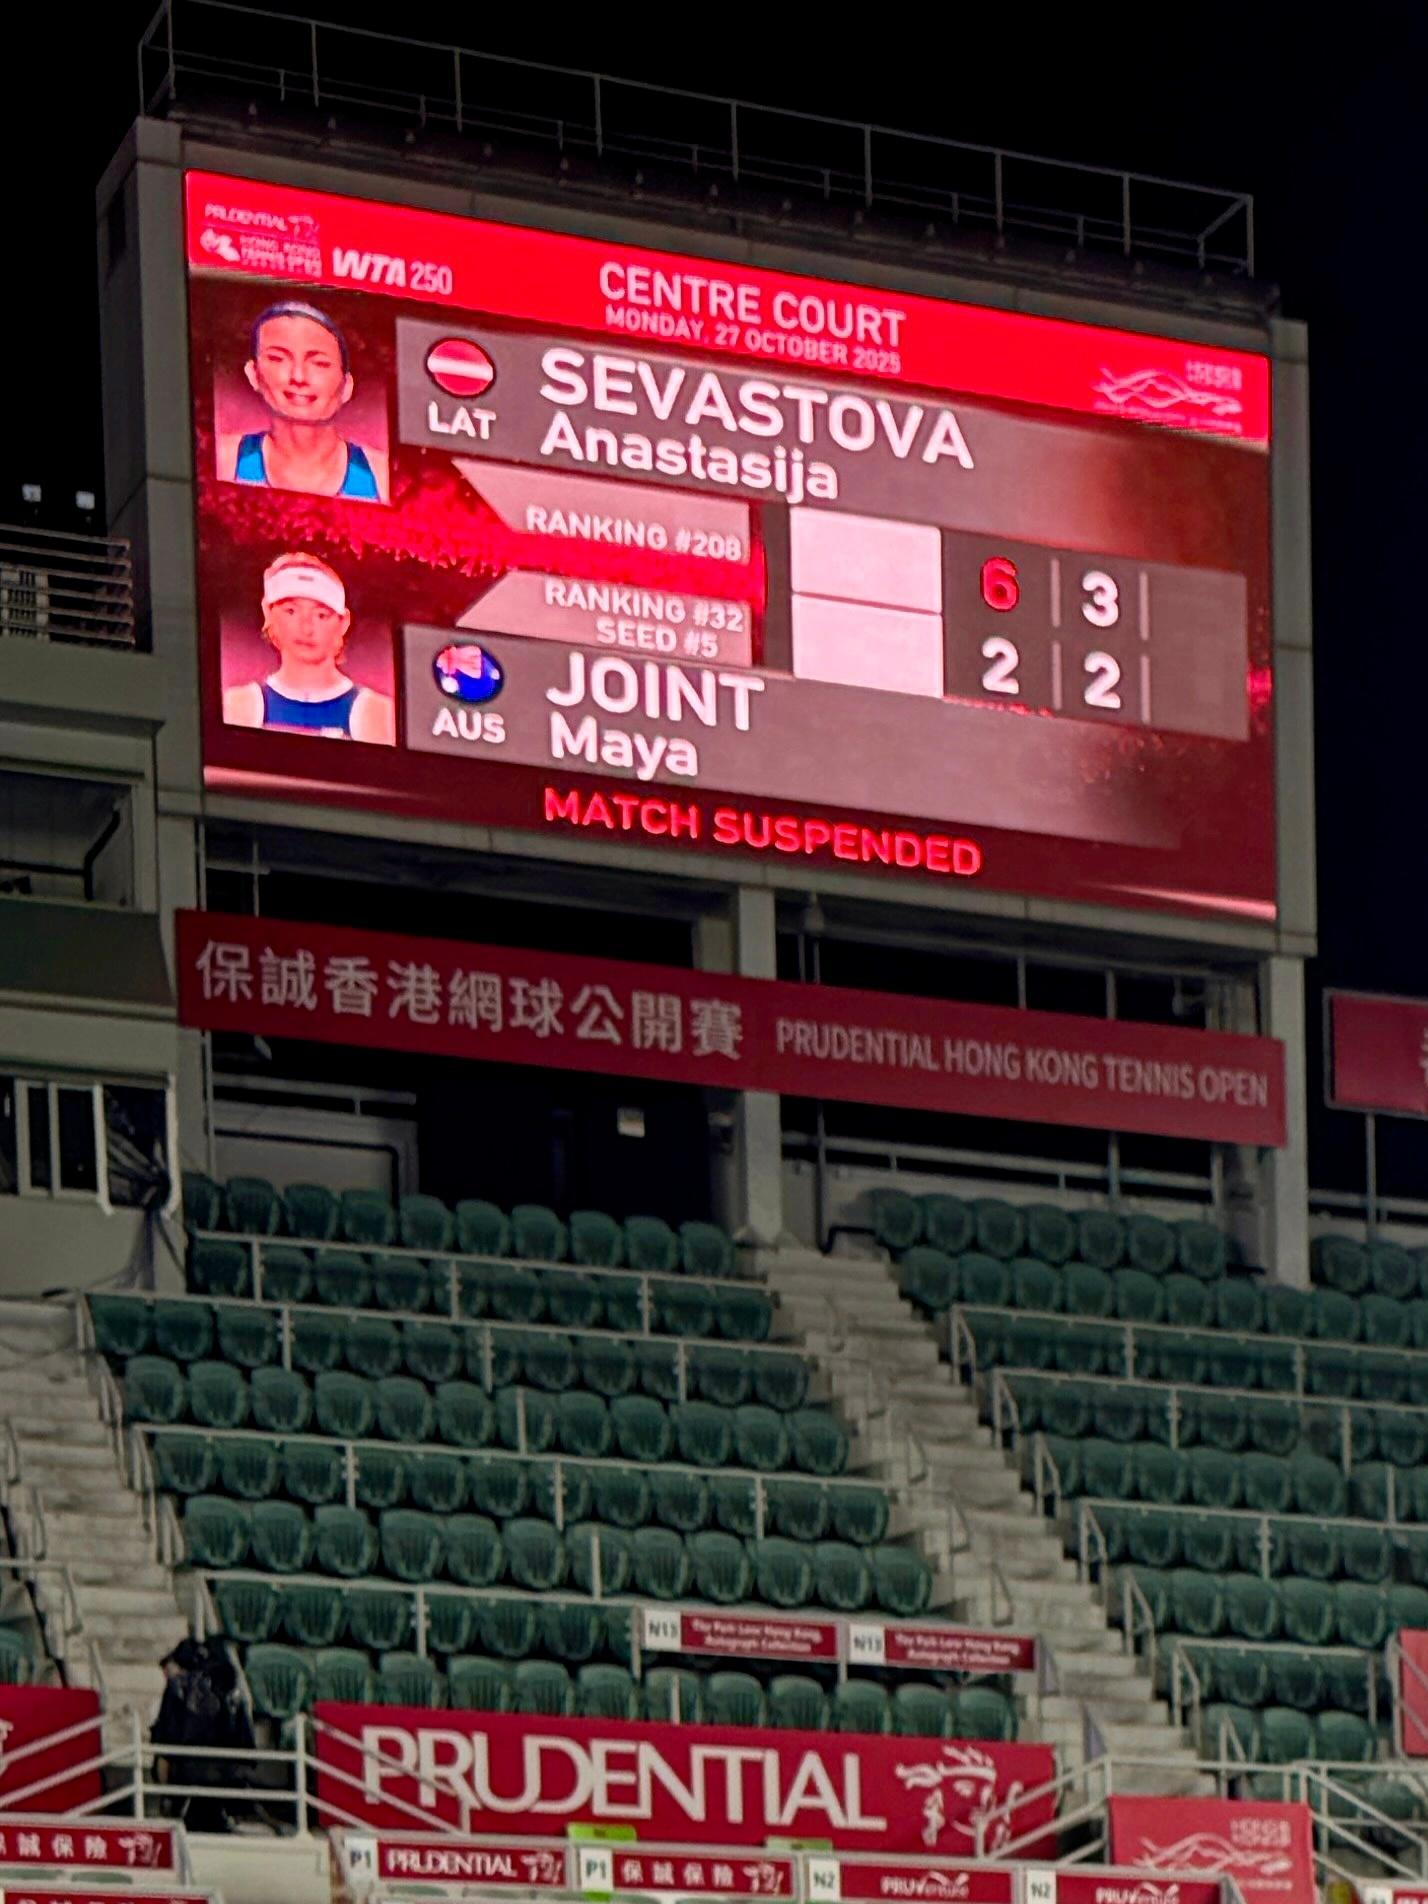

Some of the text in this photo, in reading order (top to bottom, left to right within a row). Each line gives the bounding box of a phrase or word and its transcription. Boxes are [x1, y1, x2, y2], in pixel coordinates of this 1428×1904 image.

[331, 247, 406, 287] WTA
[410, 260, 453, 296] 250
[599, 261, 906, 348] CENTRE COURT
[714, 312, 740, 347] 27
[744, 326, 848, 368] OCTOBER
[853, 343, 901, 375] 2025
[427, 400, 497, 441] LAT
[539, 346, 975, 470] SEVASTOVA
[540, 410, 839, 504] Anastasija
[526, 510, 742, 562] RANKING #208
[544, 580, 744, 633] RANKING #32
[979, 556, 1120, 628] 6 3
[596, 620, 719, 660] SEED #5
[545, 650, 766, 732] JOINT
[981, 635, 1122, 710] 2 2
[432, 706, 507, 745] AUS
[550, 710, 699, 782] Maya
[543, 786, 984, 878] MATCH SUSPENDED
[196, 939, 744, 1061] 保誠香港網球公開賽
[775, 1016, 1269, 1108] PRUDENTIAL HONG KONG TENNIS OPEN
[361, 1722, 888, 1832] PRUDENTIAL
[0, 1832, 108, 1861] 誠保險
[349, 1849, 518, 1879] P1 PRUDENTIAL
[585, 1857, 607, 1879] P1
[813, 1871, 836, 1889] N2
[1031, 1881, 1053, 1899] N2
